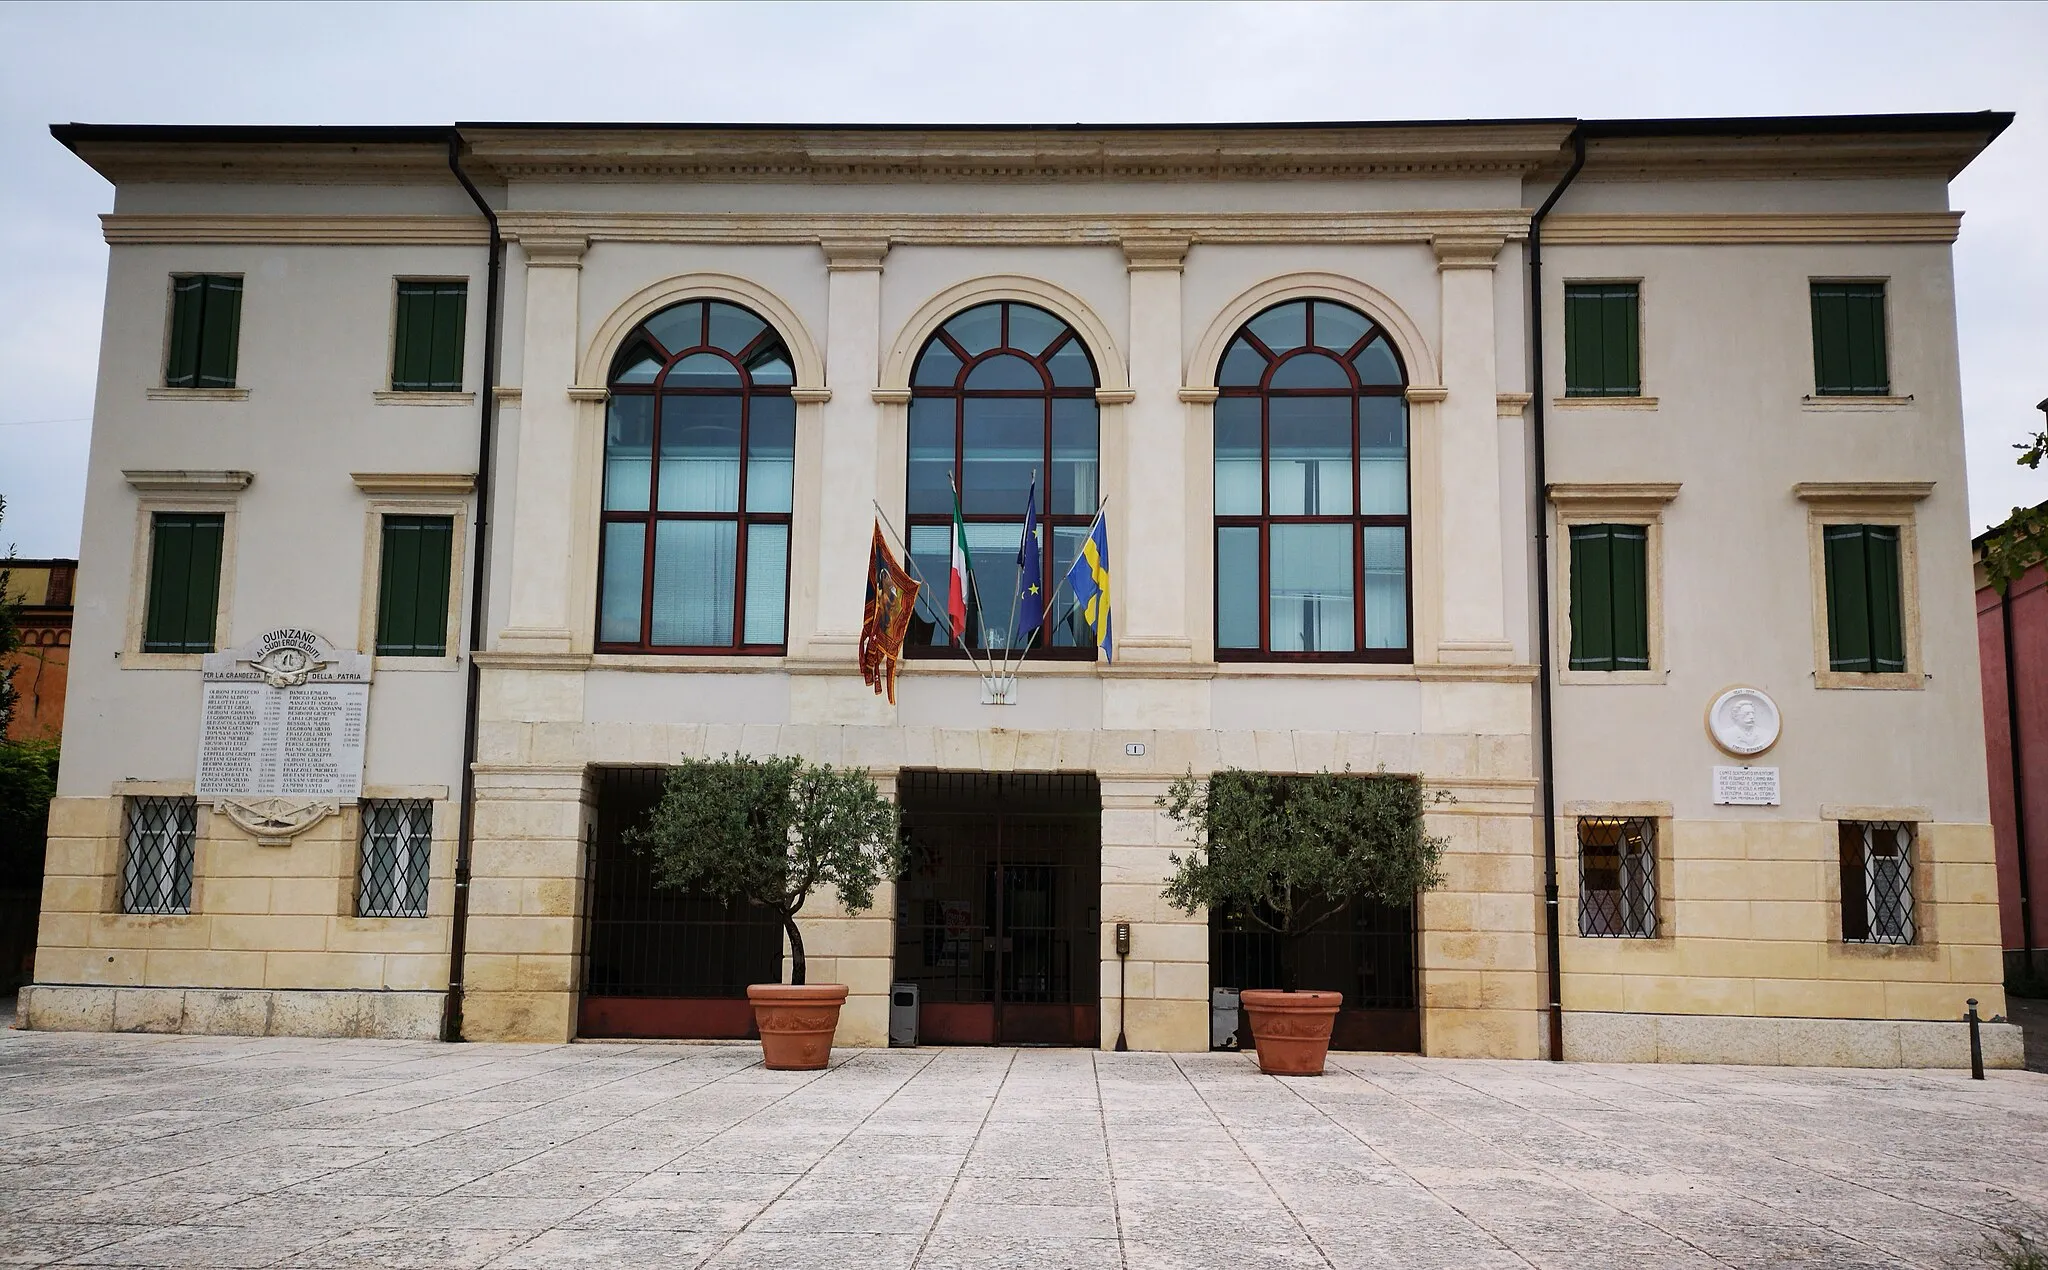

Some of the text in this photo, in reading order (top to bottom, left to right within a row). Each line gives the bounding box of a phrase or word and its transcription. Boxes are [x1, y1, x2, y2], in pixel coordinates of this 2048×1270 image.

[263, 629, 316, 644] QUINZANO
[256, 639, 321, 658] AI SUOI EROI CADUTI
